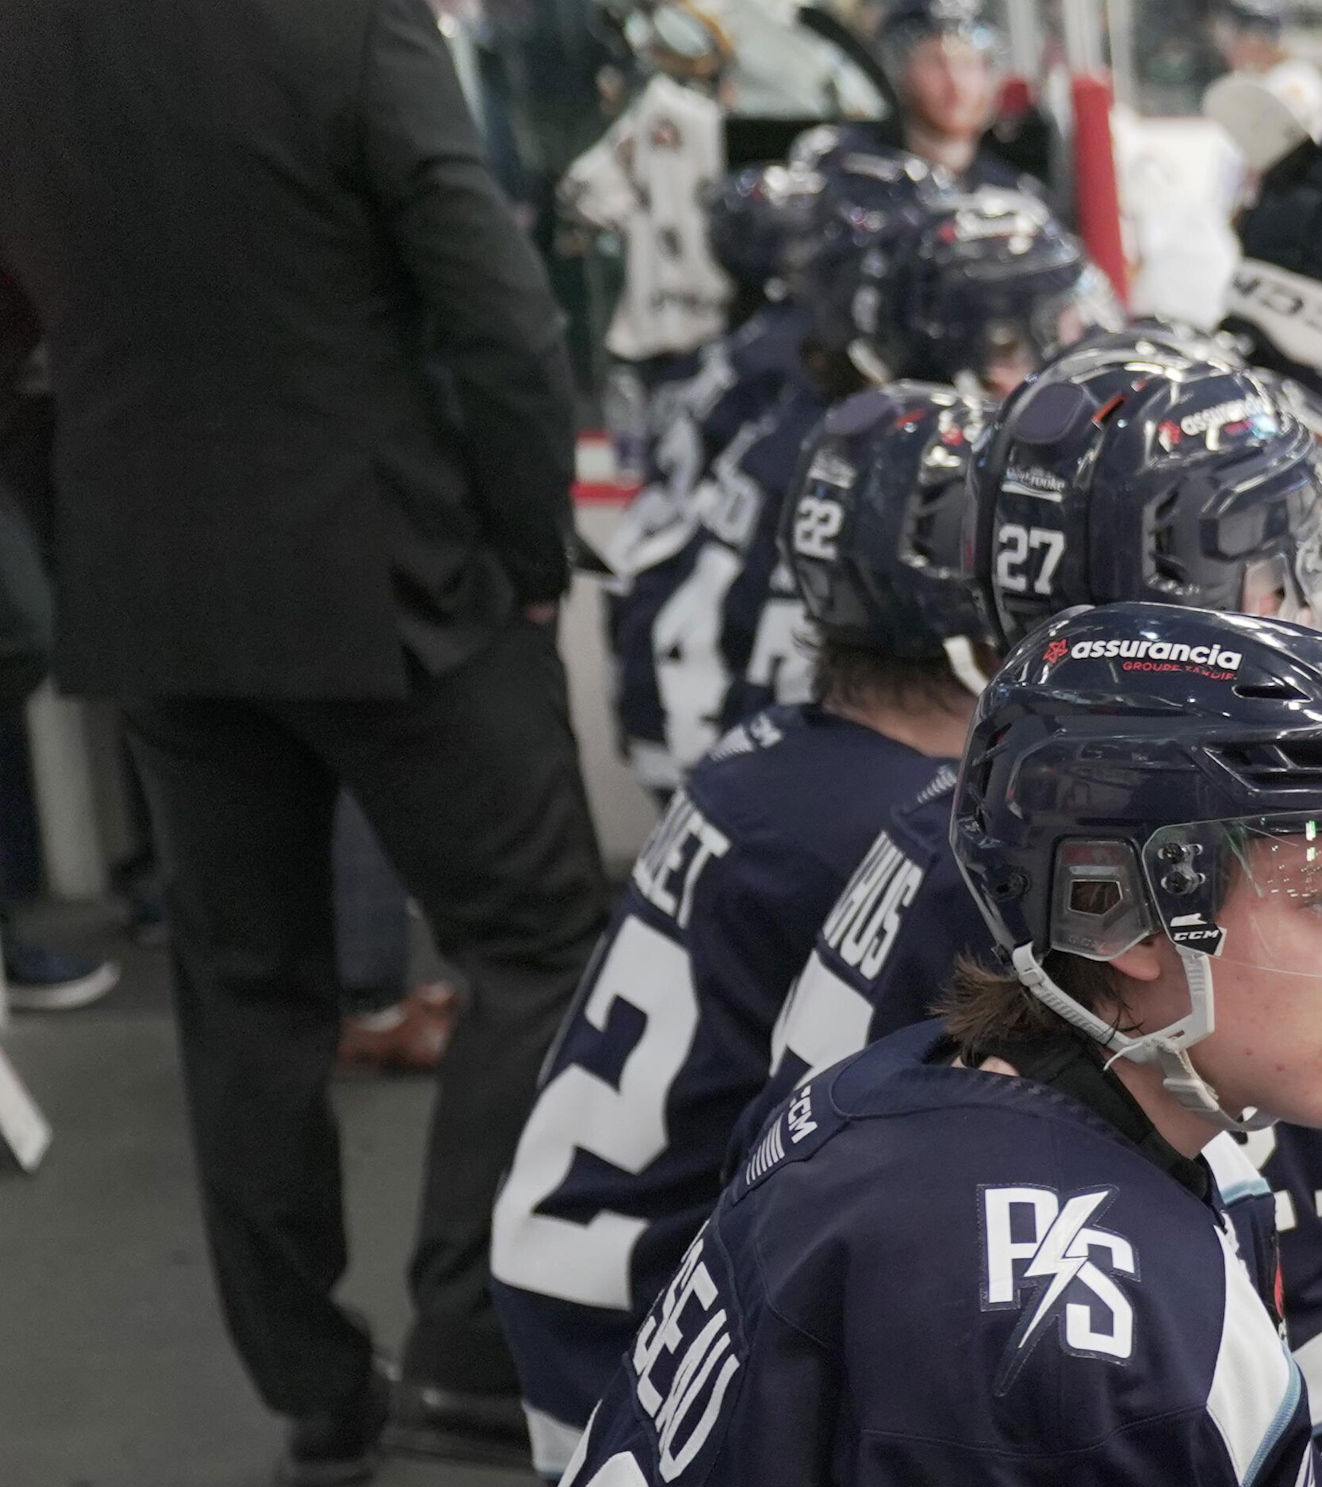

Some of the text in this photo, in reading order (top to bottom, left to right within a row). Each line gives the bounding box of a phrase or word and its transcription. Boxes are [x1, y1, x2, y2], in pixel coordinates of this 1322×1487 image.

[997, 523, 1065, 595] 27
[1070, 639, 1242, 671] assurancia
[1173, 929, 1220, 942] CCM
